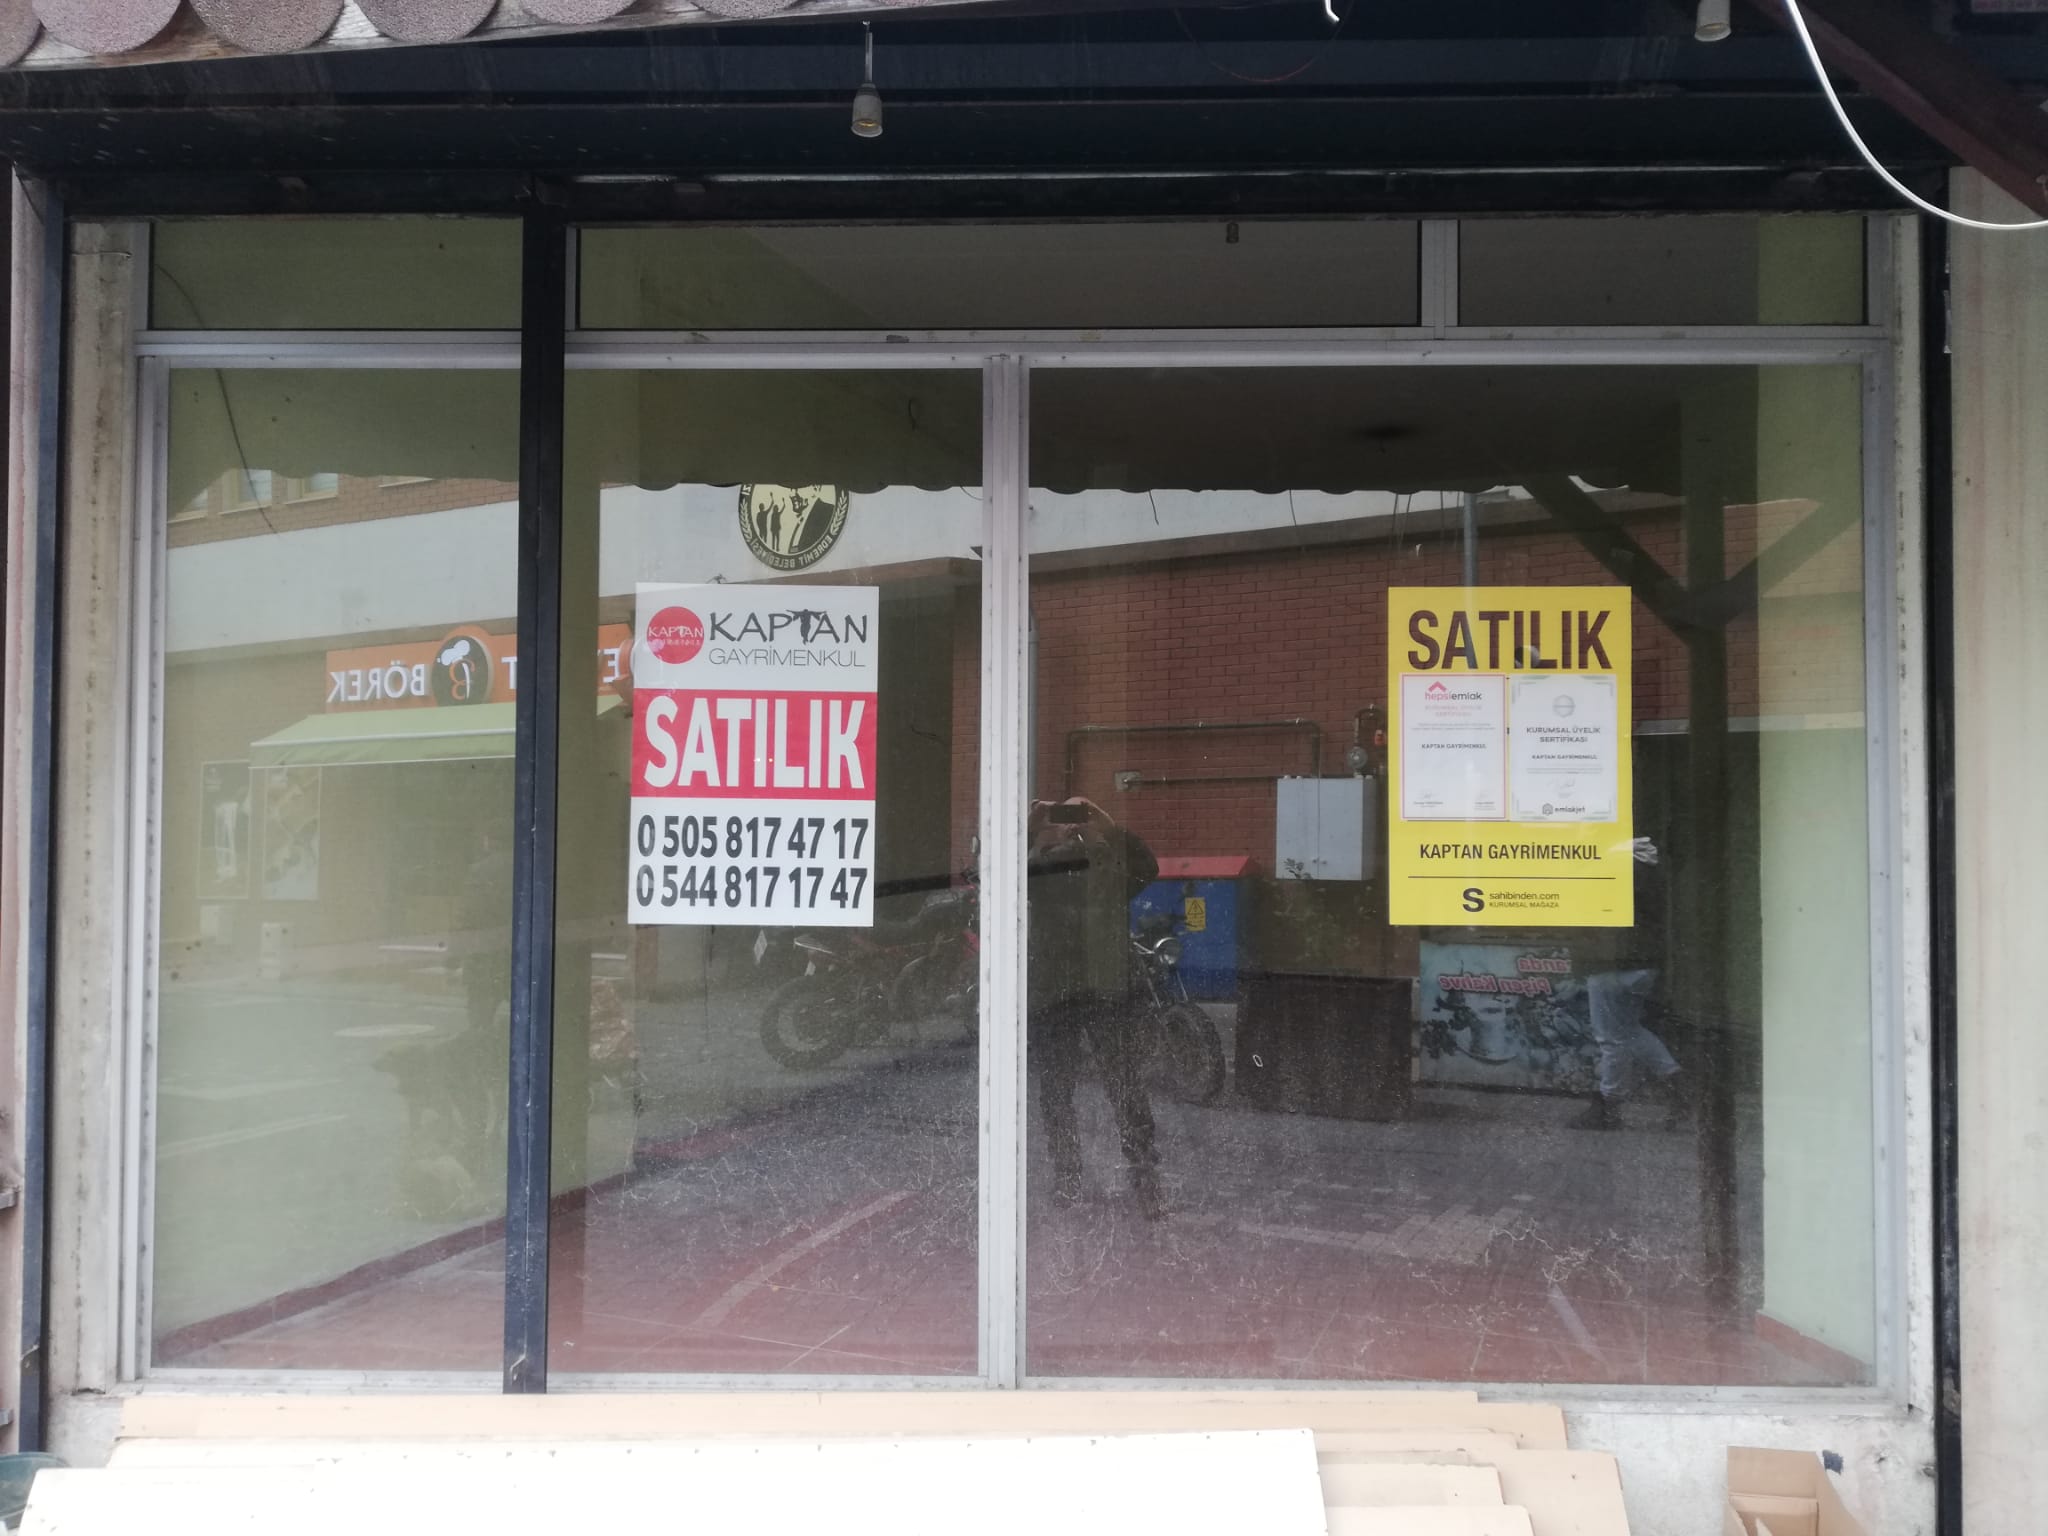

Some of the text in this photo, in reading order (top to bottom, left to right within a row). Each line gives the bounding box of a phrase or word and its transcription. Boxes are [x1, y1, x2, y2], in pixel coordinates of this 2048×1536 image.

[648, 625, 704, 639] KAPTAN
[709, 608, 867, 645] KAPTAN
[1408, 609, 1613, 670] SATILIK
[709, 645, 866, 667] GAYRİMENKUL
[643, 695, 866, 790] SATILIK
[637, 814, 869, 859] 0 505 817 47 17
[1420, 841, 1602, 860] KAPTAN GAYRİMENKUL
[636, 863, 868, 909] 0 544 817 17 47
[1489, 891, 1560, 901] sahibinden.com
